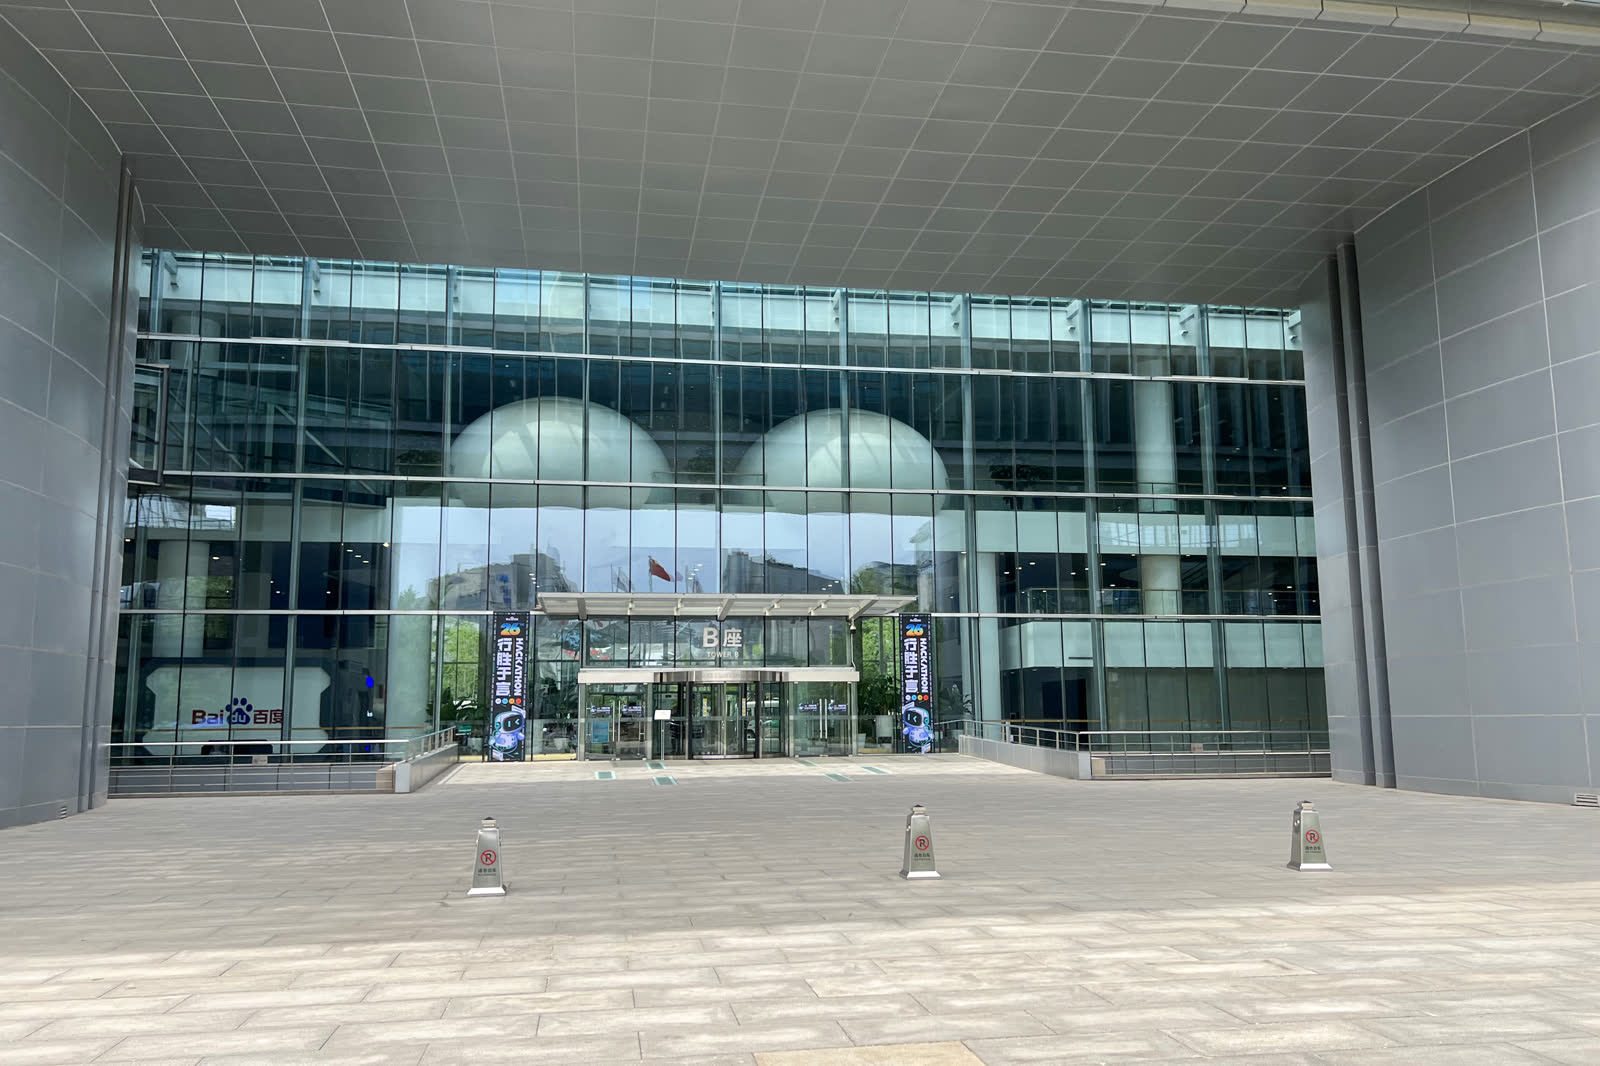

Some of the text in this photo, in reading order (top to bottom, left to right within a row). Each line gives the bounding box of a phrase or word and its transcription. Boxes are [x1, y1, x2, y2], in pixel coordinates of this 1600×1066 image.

[703, 627, 742, 648] B座
[514, 637, 524, 696] HACKATHON
[920, 637, 929, 693] HACKATHON
[253, 709, 283, 725] 百度
